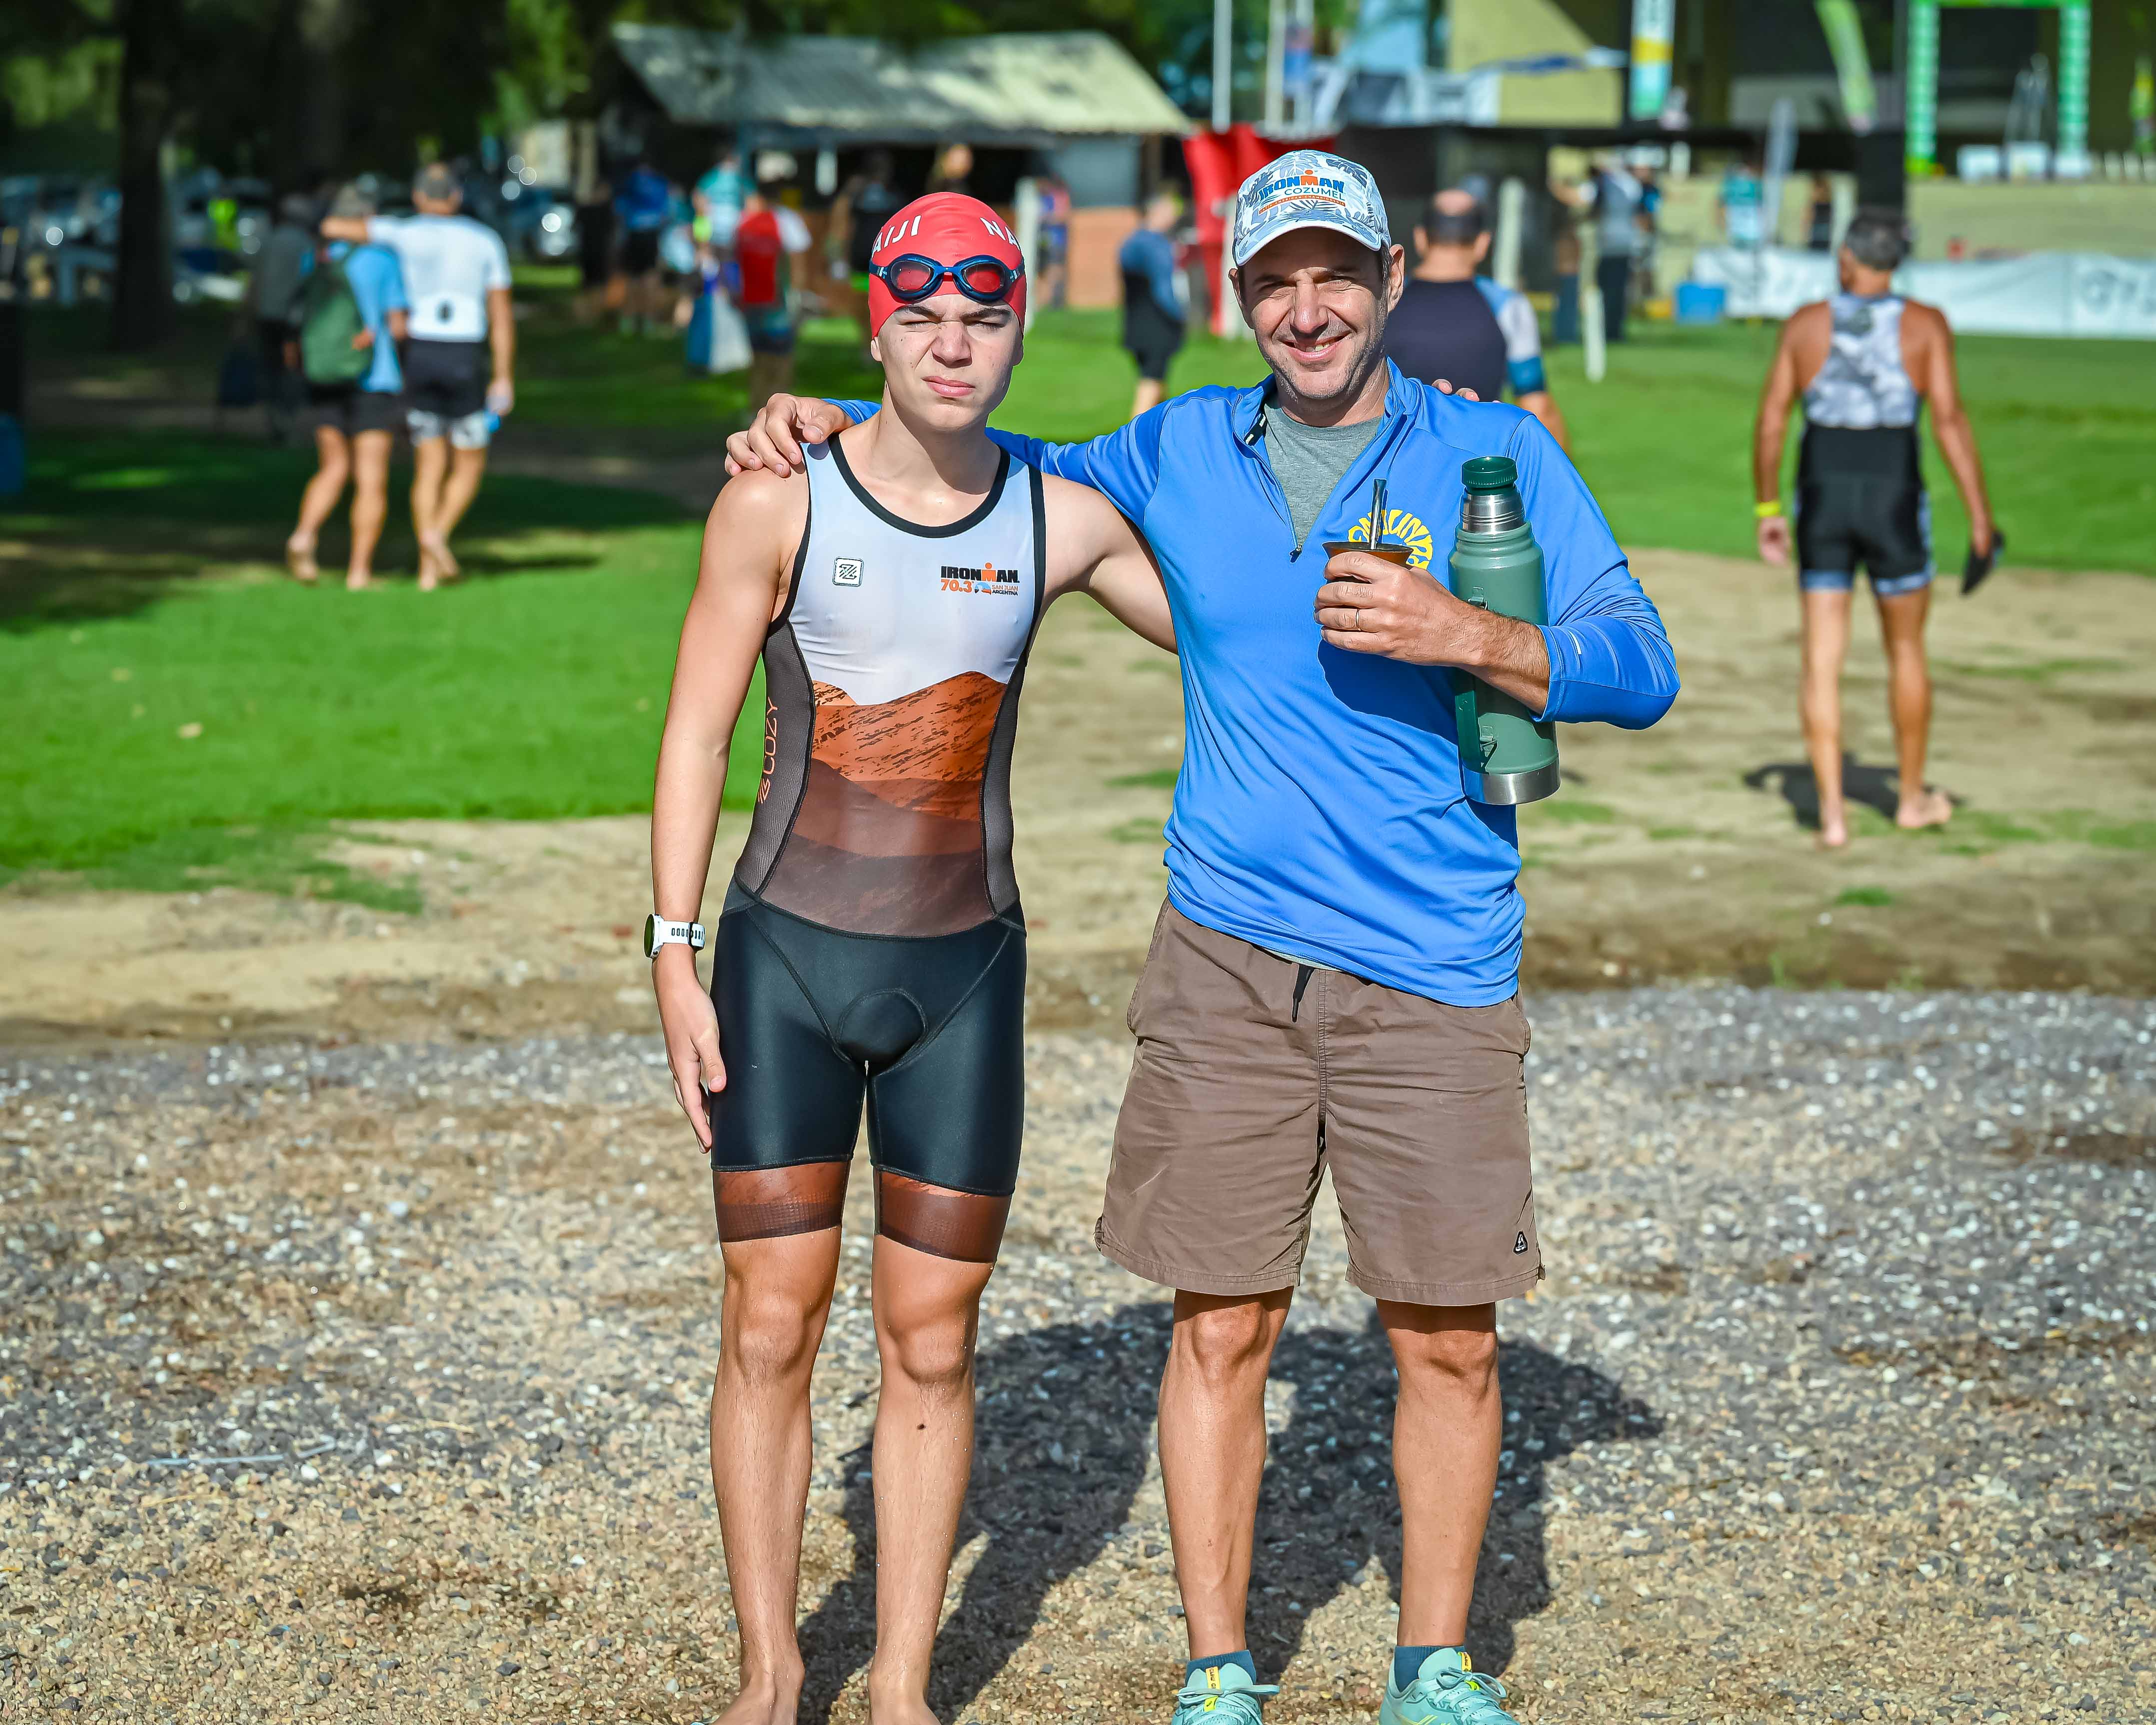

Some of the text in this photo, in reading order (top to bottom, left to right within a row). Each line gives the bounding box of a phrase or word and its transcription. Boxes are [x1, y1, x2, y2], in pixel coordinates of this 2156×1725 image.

[1259, 170, 1344, 200] IRONMAN
[1275, 196, 1302, 204] AMERICAN
[1285, 188, 1345, 200] COZUMEL
[941, 562, 1020, 583] IRONMAN
[941, 579, 972, 592] 70.3
